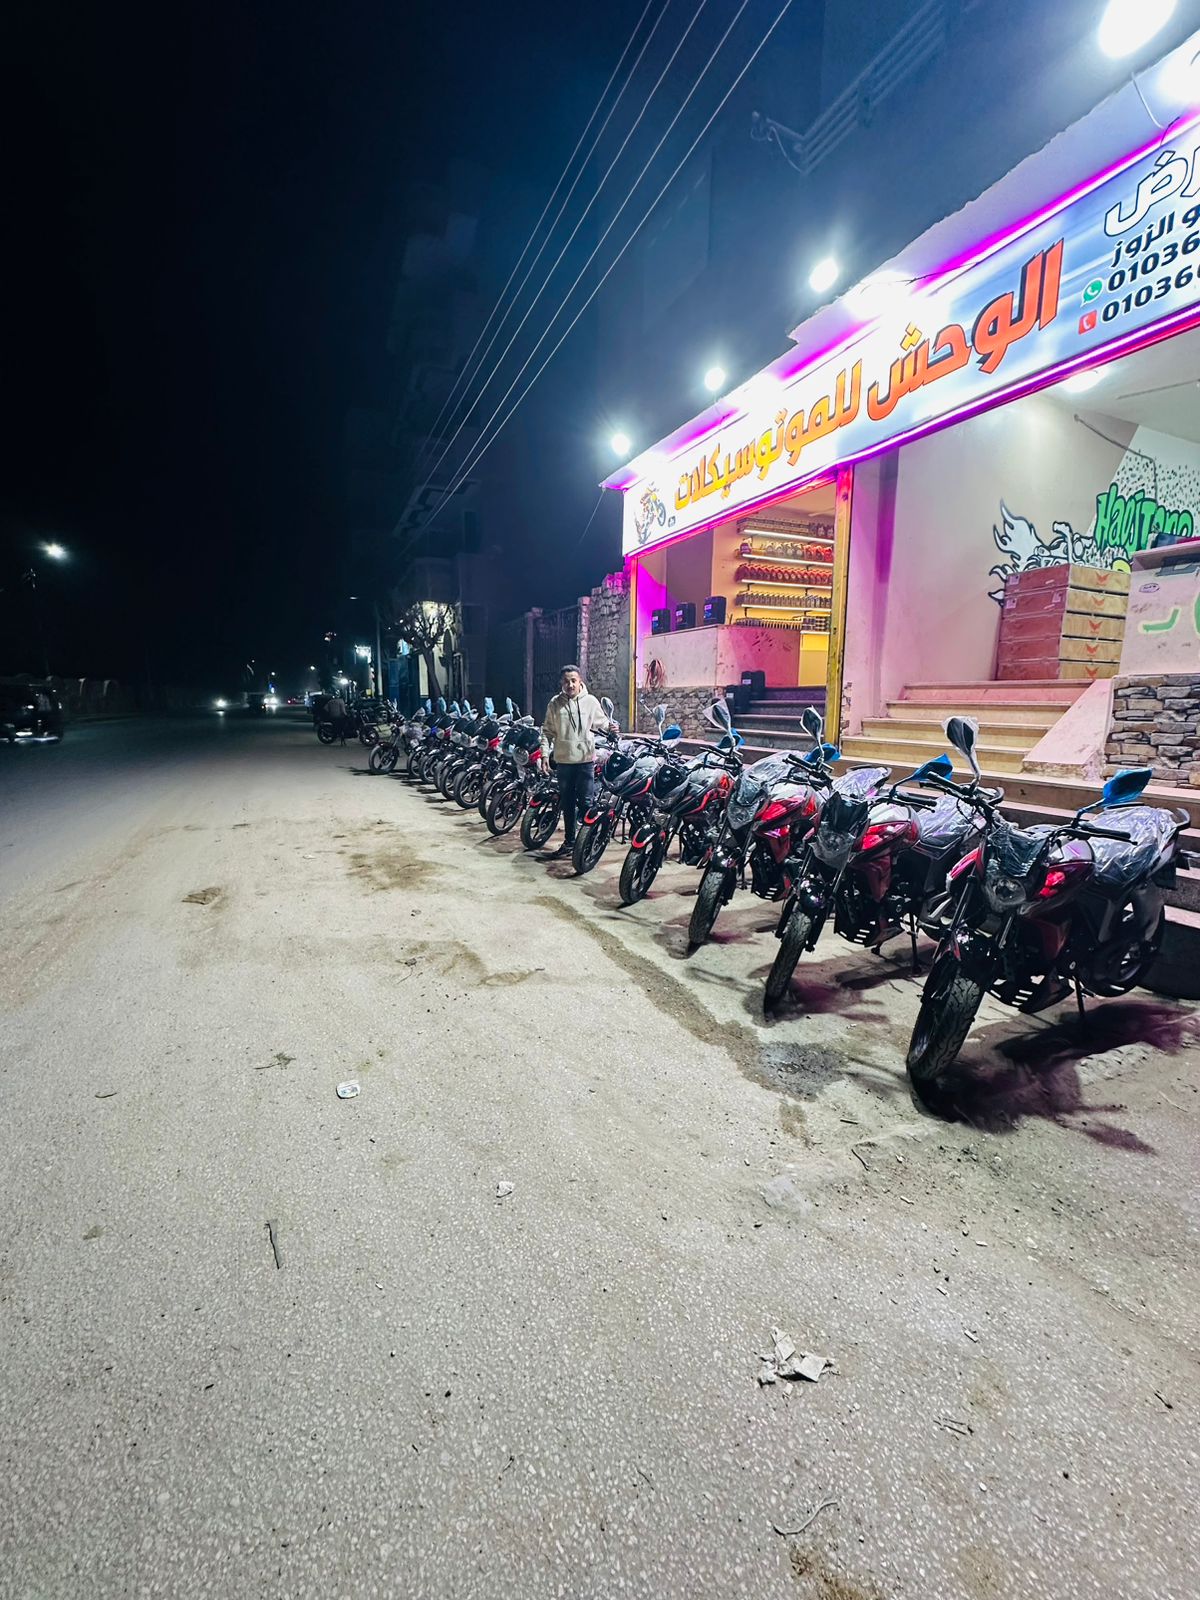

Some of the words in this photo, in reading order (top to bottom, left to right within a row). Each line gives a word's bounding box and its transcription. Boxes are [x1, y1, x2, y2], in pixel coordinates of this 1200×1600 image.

[866, 237, 1064, 421] الوحش
[1102, 263, 1200, 322] 01036
[674, 358, 863, 511] للموتوسيكلات
